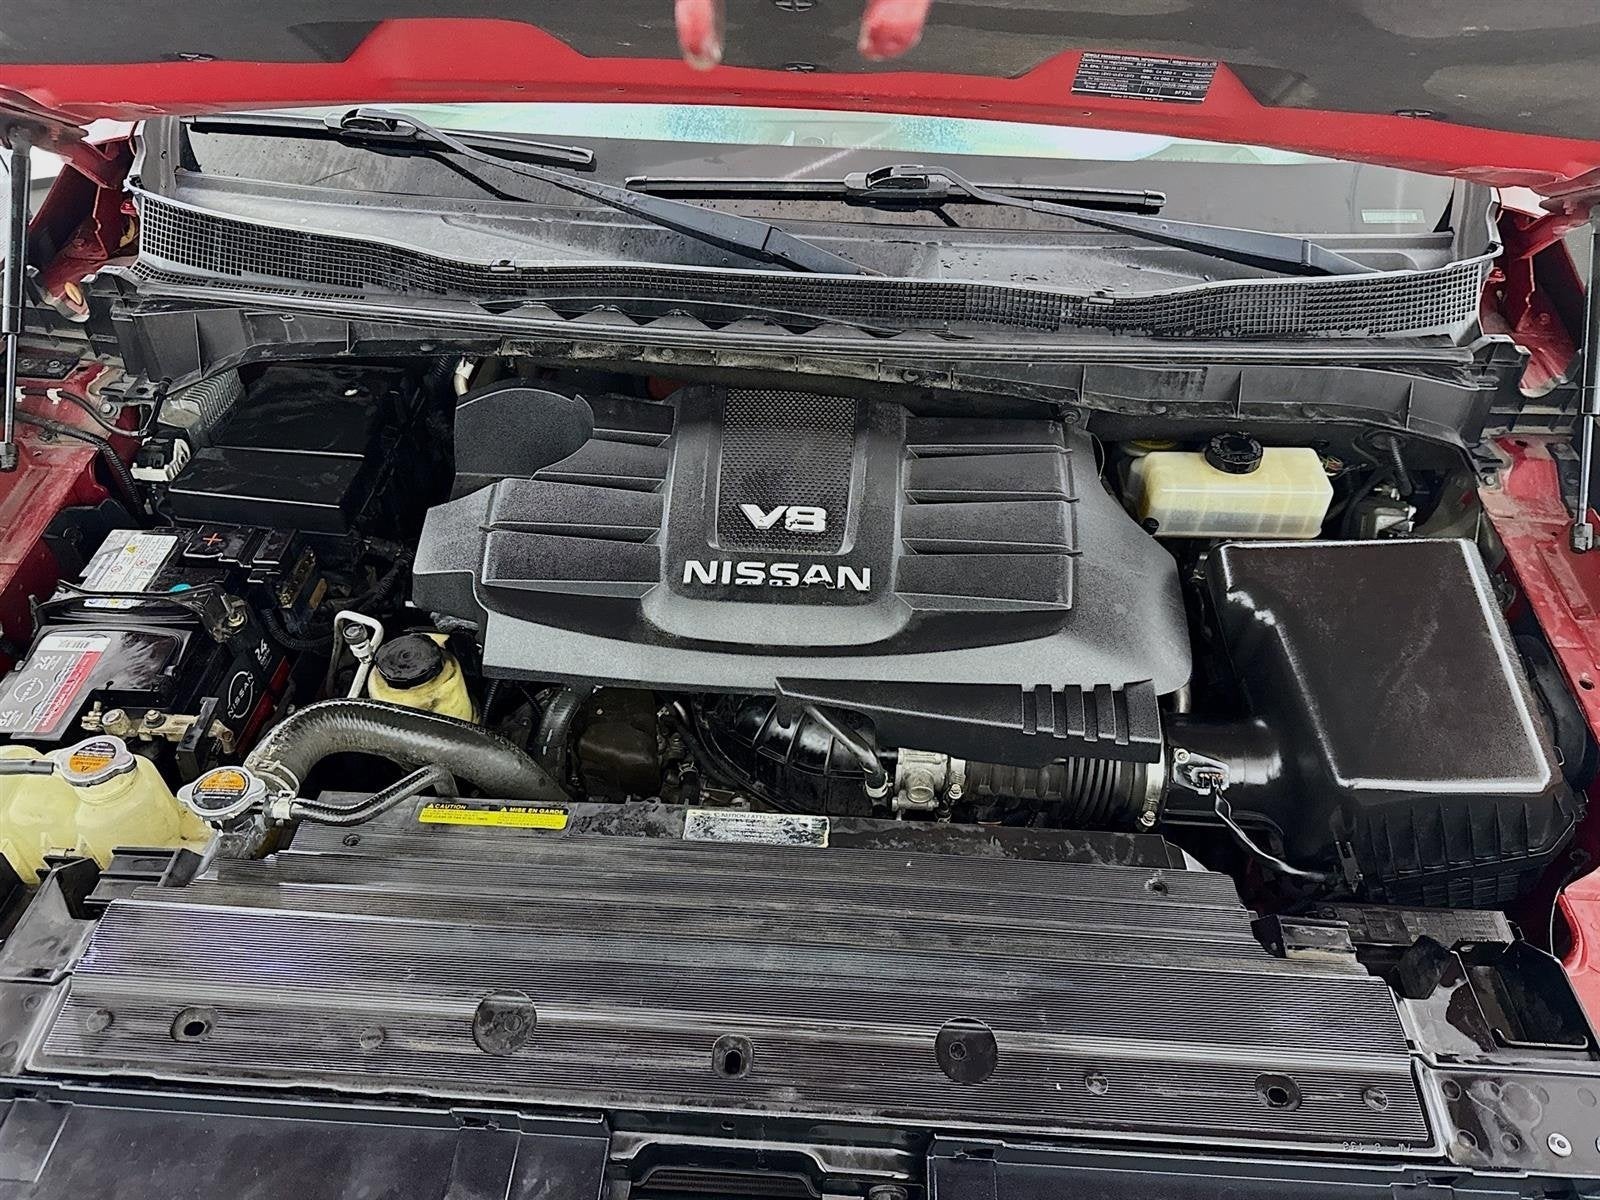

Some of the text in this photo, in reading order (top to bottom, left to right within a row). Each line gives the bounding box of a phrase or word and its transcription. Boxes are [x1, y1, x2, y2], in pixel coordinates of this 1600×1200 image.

[739, 504, 827, 532] V8
[682, 560, 871, 592] NISSAN
[254, 638, 268, 660] 24
[18, 678, 39, 702] NISSAN
[228, 672, 254, 718] NISSAN
